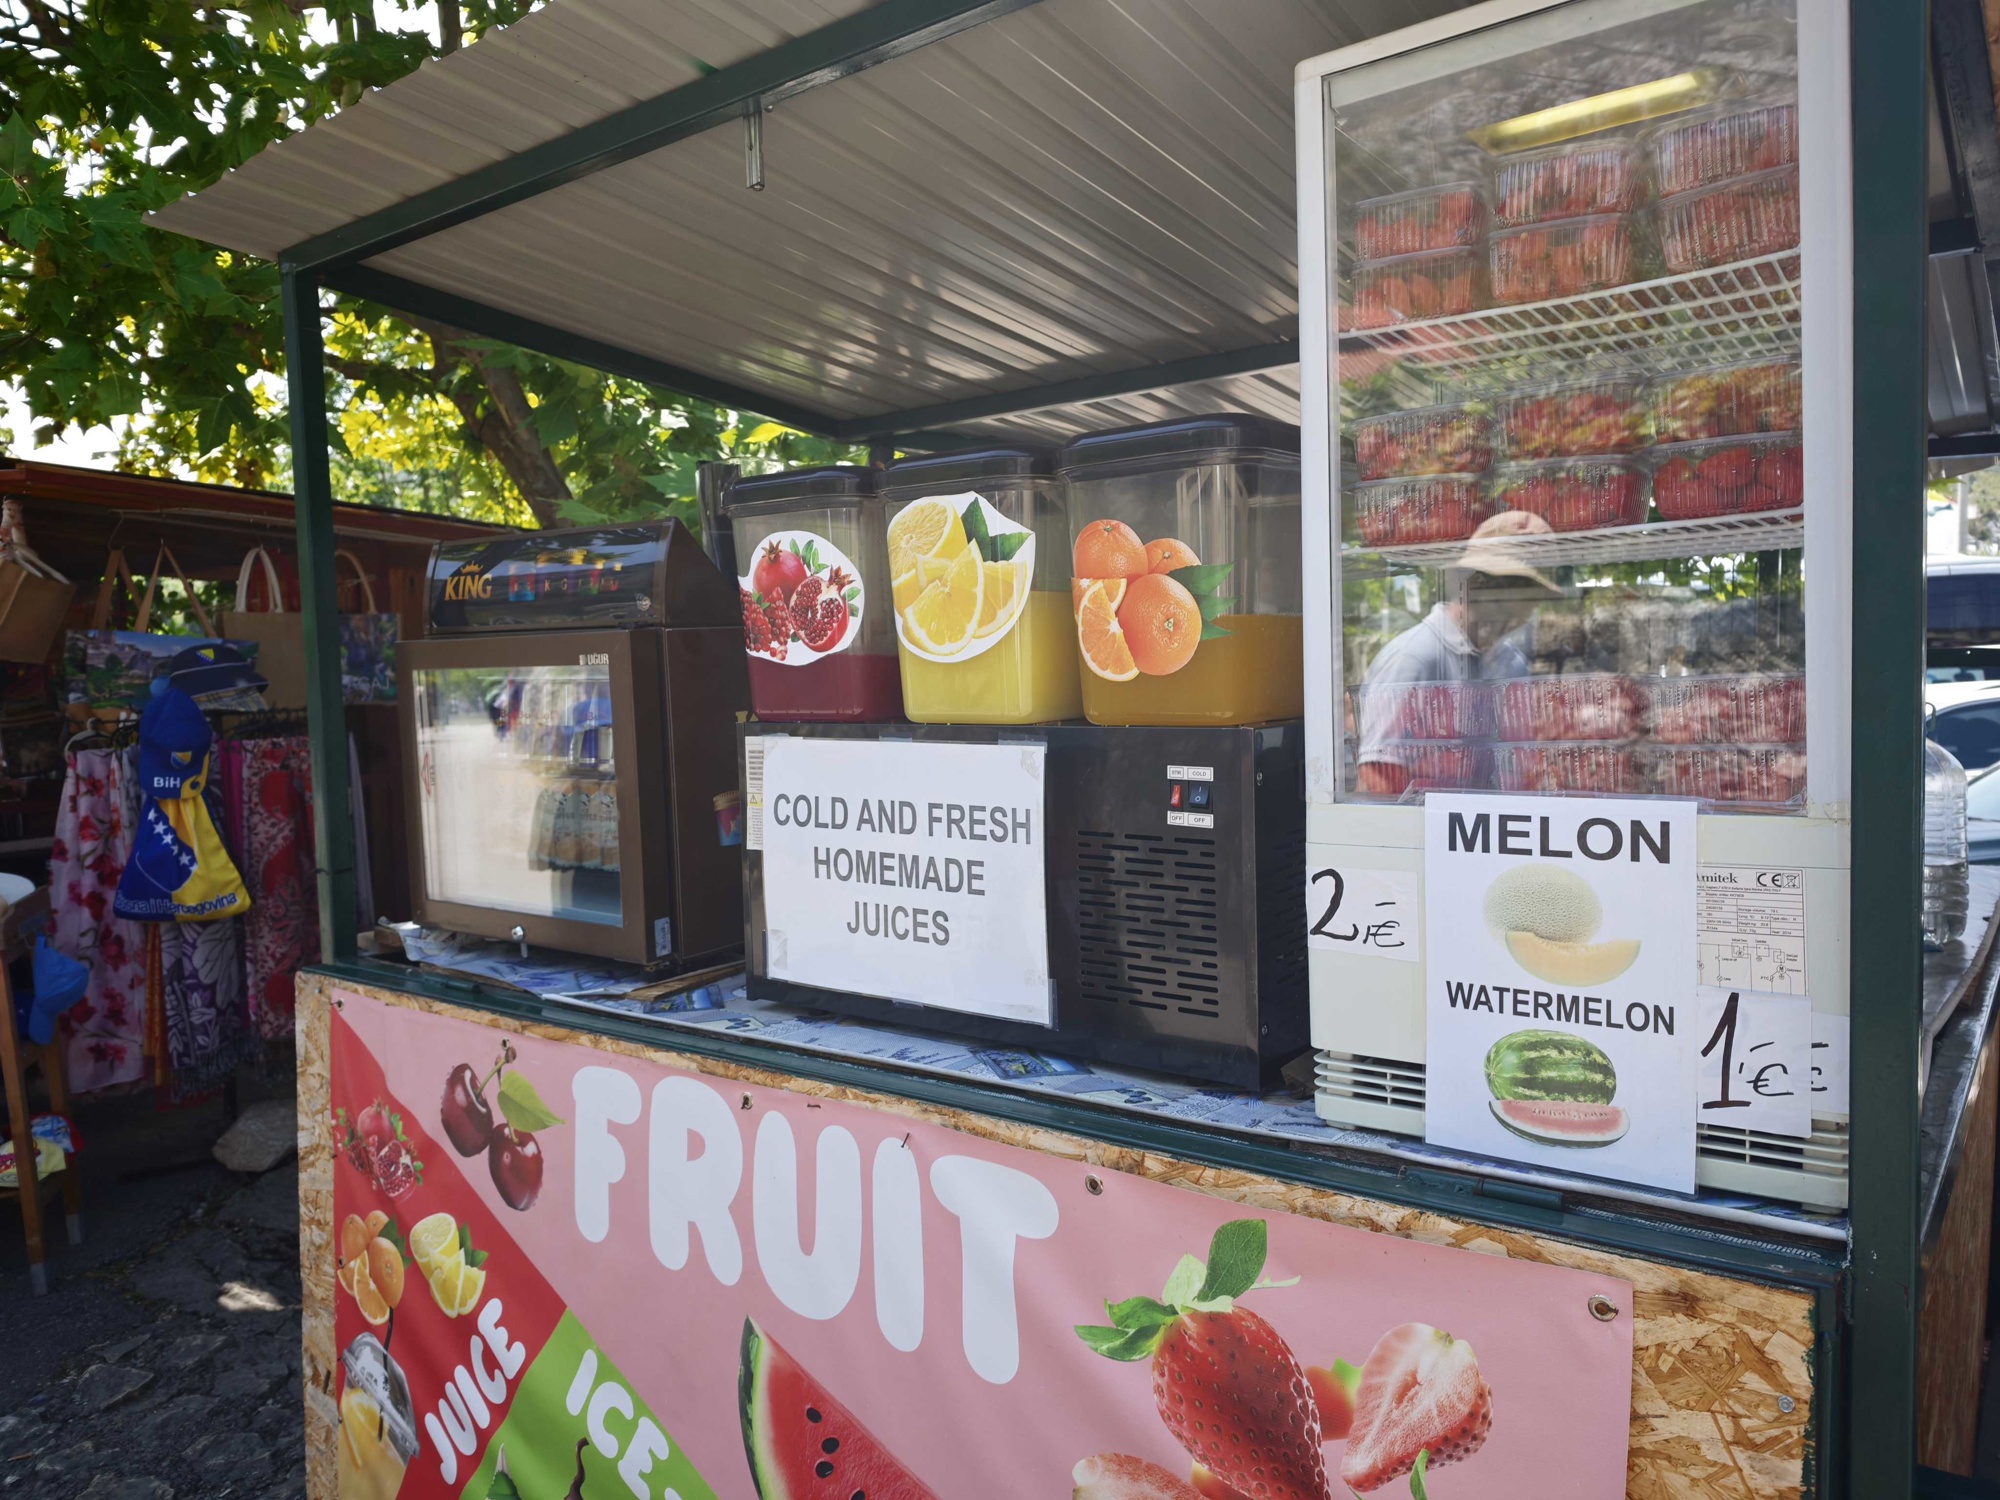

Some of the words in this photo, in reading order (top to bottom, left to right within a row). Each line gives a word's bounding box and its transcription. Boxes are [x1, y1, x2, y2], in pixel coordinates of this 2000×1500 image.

[444, 574, 493, 601] KING
[153, 776, 181, 789] BiH
[773, 793, 848, 830] COLD
[856, 798, 917, 835] AND
[927, 802, 1031, 845] FRESH
[1448, 811, 1670, 864] MELON
[813, 846, 986, 896] HOMEMADE
[846, 901, 950, 946] JUICES
[1446, 980, 1675, 1035] WATERMELON
[572, 1066, 1060, 1385] FRUIT
[424, 1297, 526, 1485] JUICE
